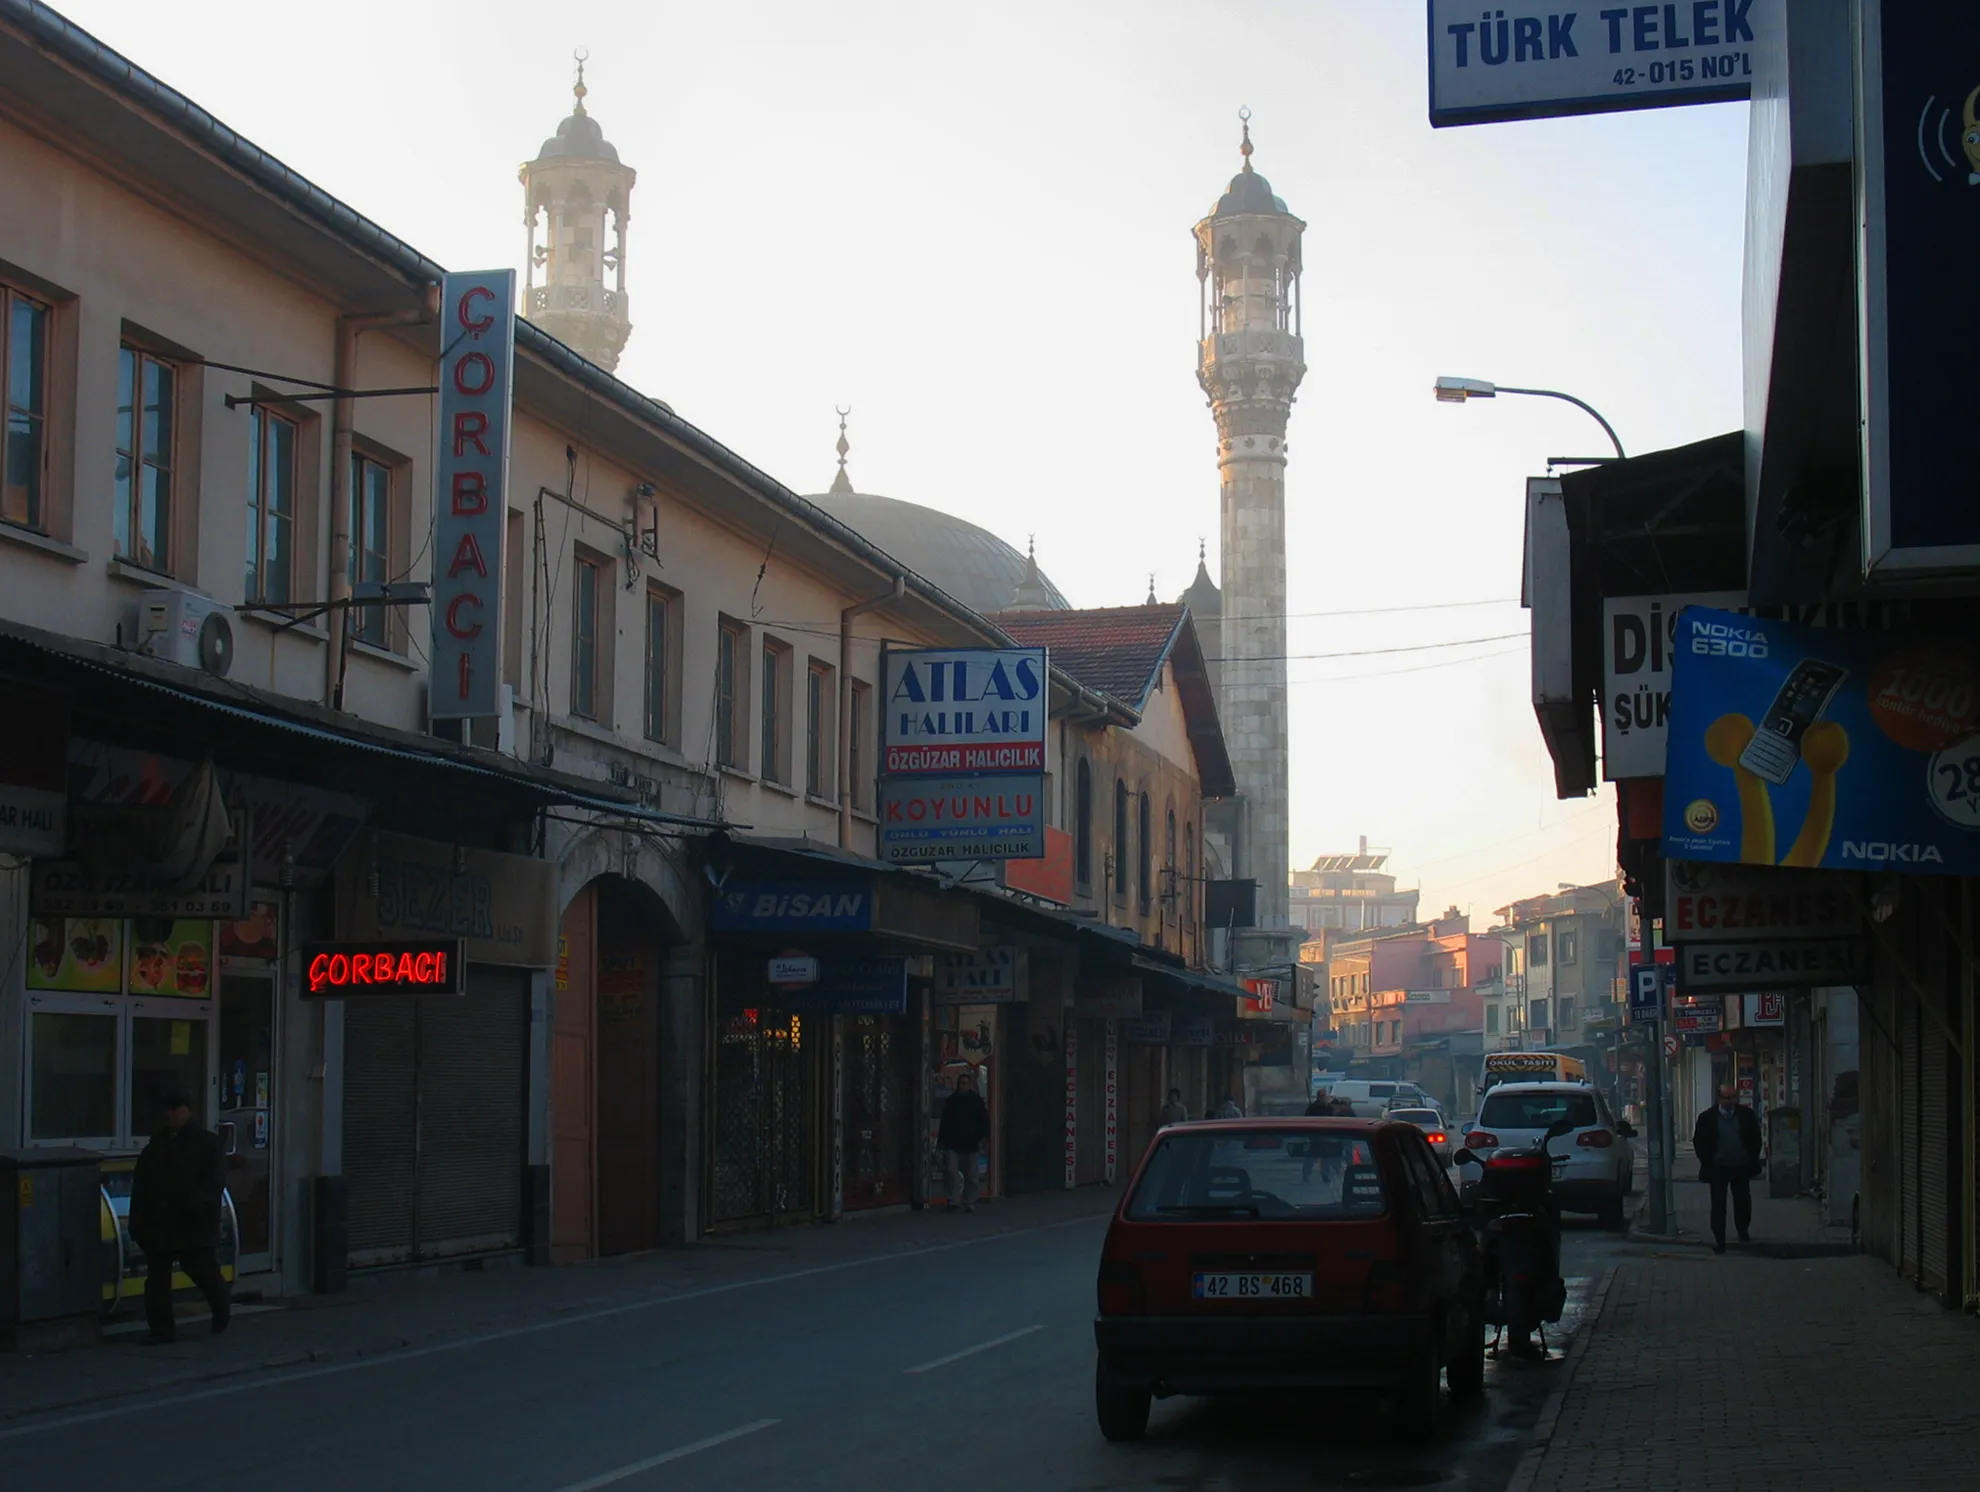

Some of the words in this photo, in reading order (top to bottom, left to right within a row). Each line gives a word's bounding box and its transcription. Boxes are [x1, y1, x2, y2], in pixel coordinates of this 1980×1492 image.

[1448, 9, 1580, 69] TÜRK
[1600, 0, 1754, 54] TELEK
[1613, 58, 1695, 86] 42-015
[446, 285, 496, 700] ÇORBACI
[1691, 620, 1769, 645] NOKIA
[1691, 637, 1769, 659] 6300
[891, 657, 1040, 703] ATLAS
[900, 709, 1030, 736] HALILARI
[888, 746, 960, 771] ÖZGÜZAR
[966, 747, 1041, 768] HALICILIK
[21, 809, 53, 832] HALI
[886, 794, 1033, 823] KOYUNLU
[1841, 840, 1945, 865] NOKIA
[378, 855, 495, 940] SEZER
[308, 951, 448, 994] ÇORBACI
[1638, 970, 1656, 1002] P
[1489, 1059, 1518, 1067] OKUL
[1207, 1276, 1229, 1296] 42
[1239, 1276, 1260, 1296] BS
[1270, 1276, 1304, 1297] 468
